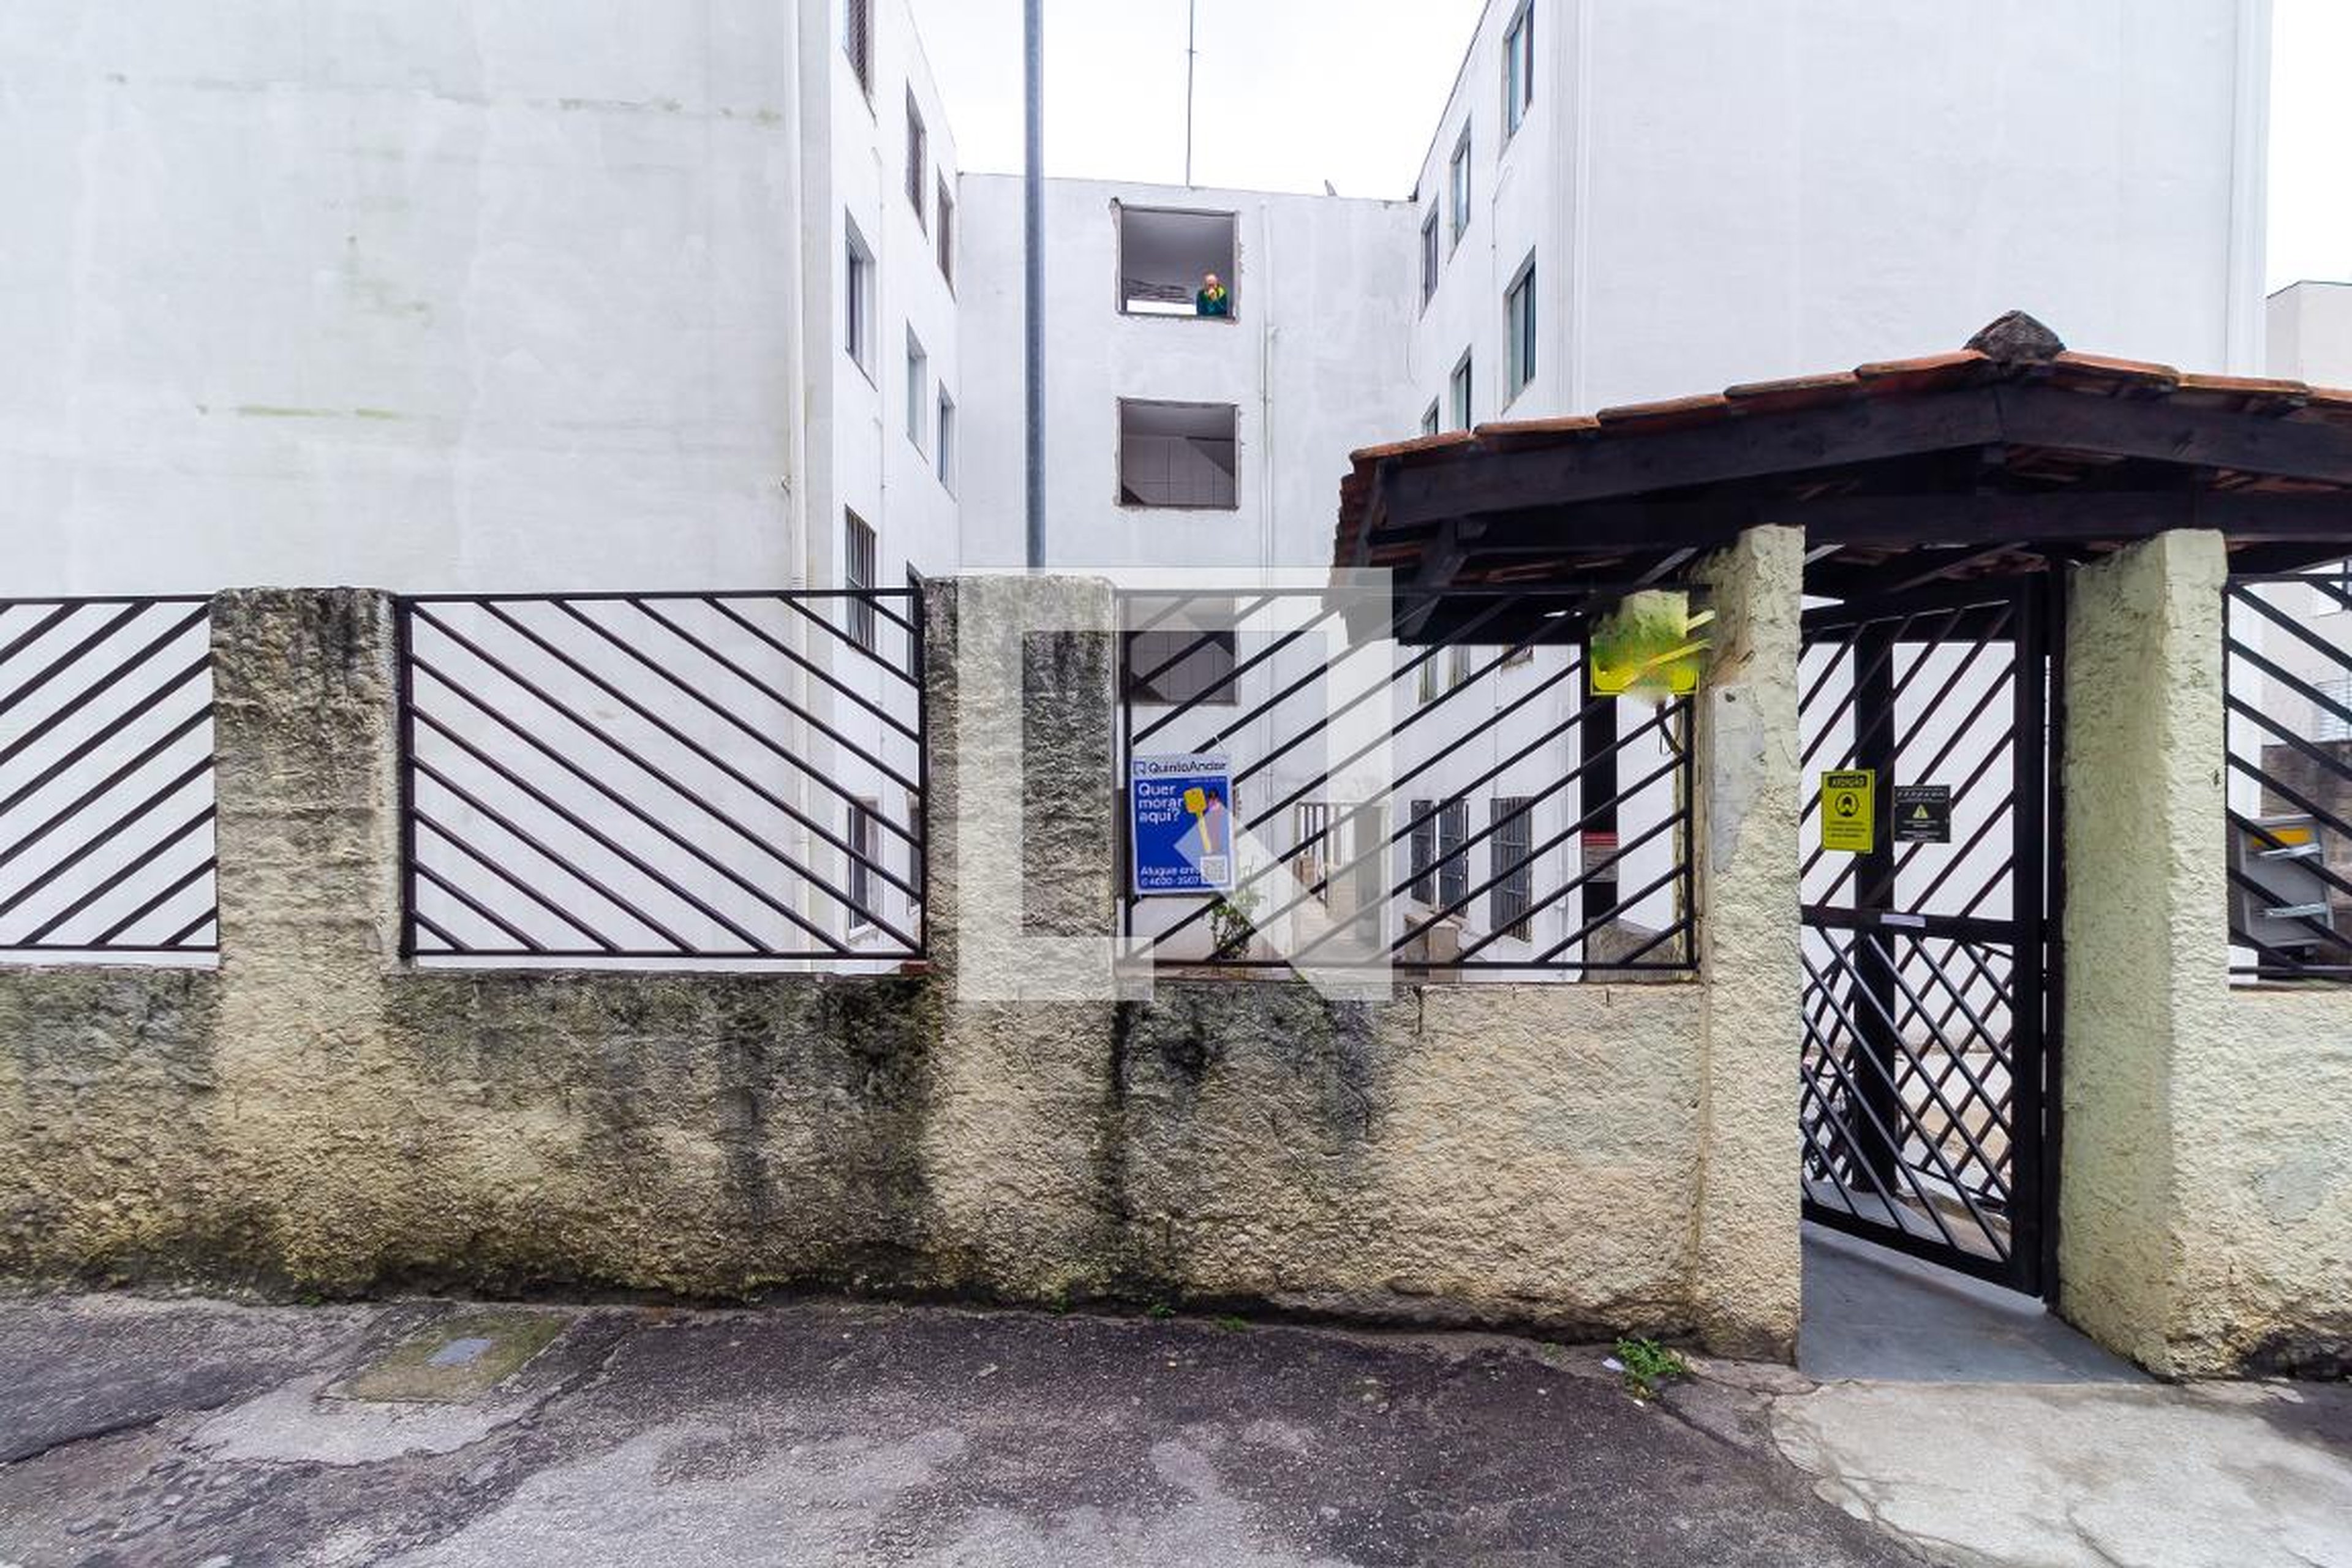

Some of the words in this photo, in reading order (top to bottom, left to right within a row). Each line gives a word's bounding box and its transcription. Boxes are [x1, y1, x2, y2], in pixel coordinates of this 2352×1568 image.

[1148, 761, 1226, 773] QuintoAndar
[1139, 783, 1176, 796] Quer
[1139, 797, 1183, 809] morar
[1139, 807, 1181, 824] aqui?
